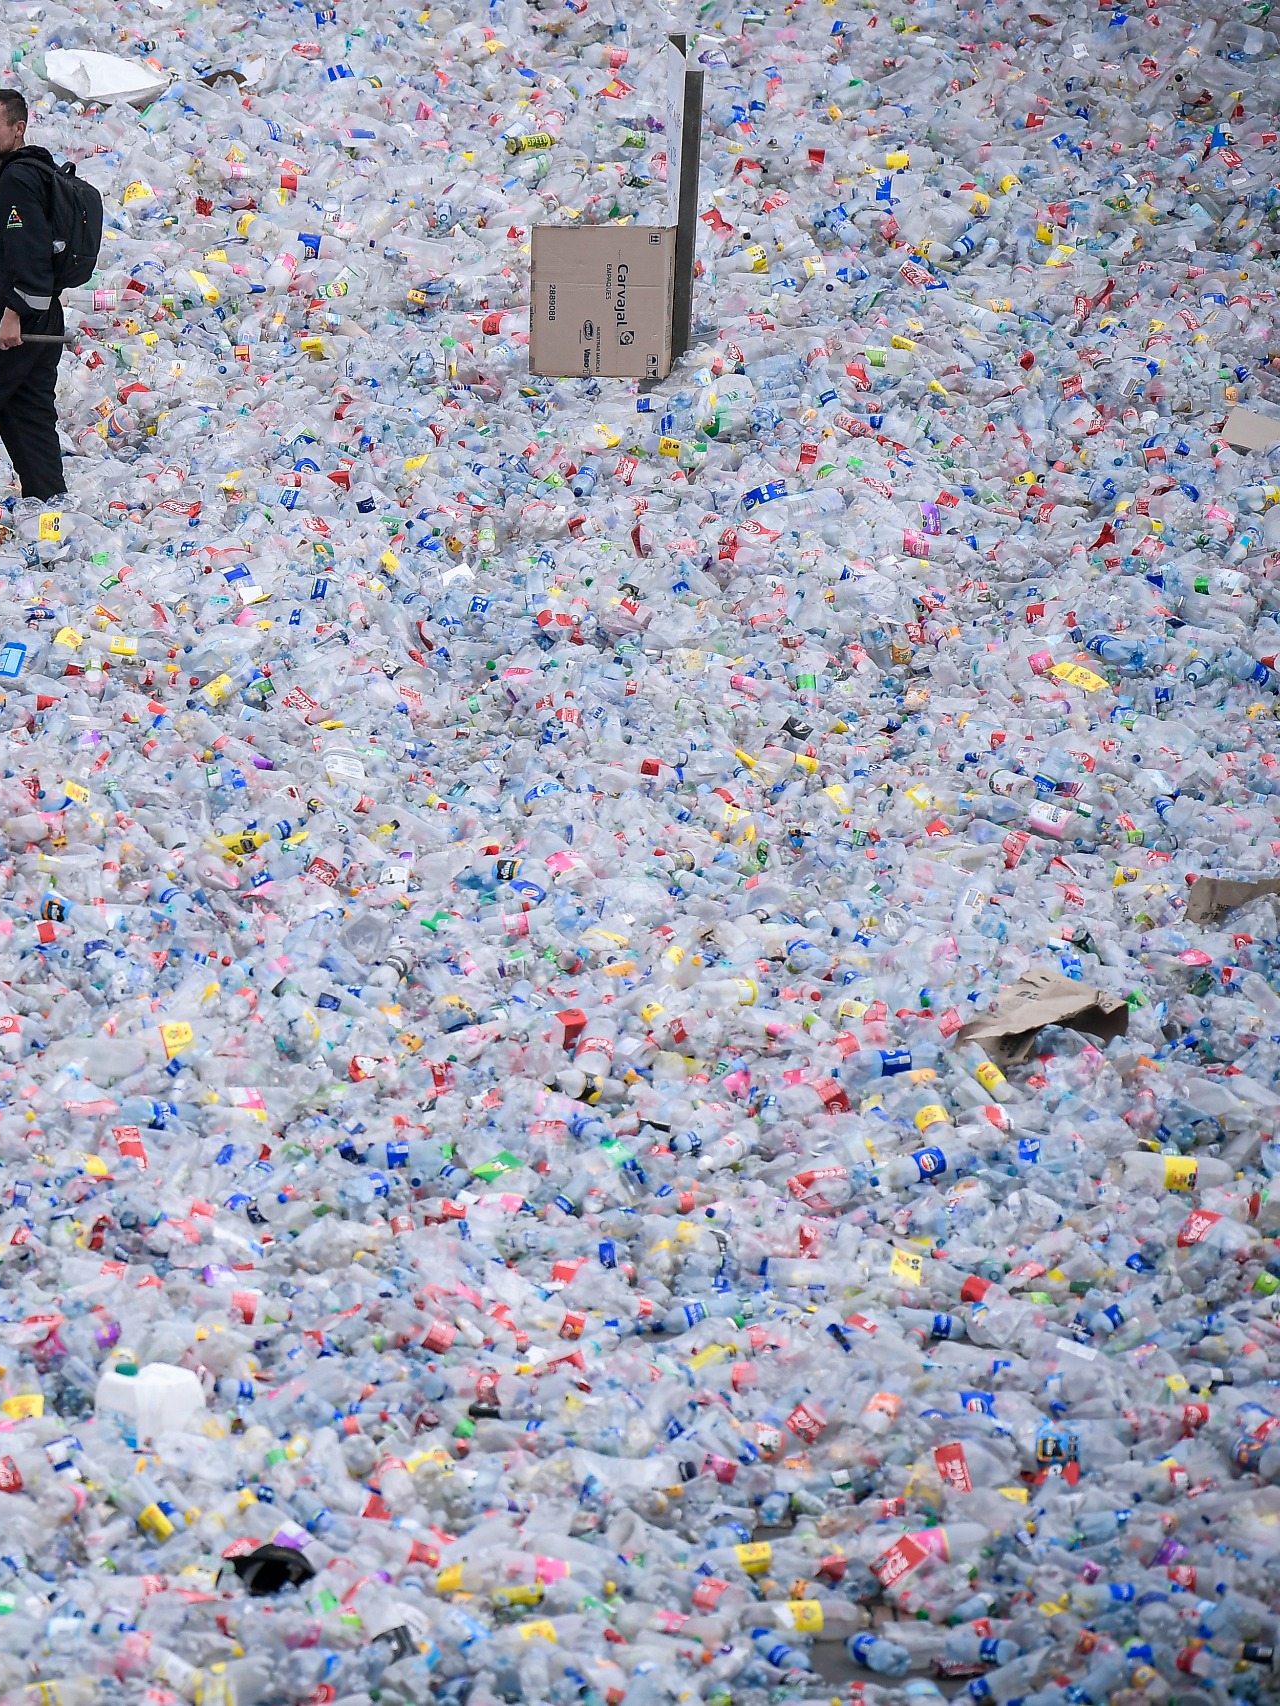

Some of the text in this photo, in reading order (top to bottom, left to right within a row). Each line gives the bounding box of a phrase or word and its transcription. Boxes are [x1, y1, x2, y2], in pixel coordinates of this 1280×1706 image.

[527, 135, 548, 147] SPEED
[605, 263, 613, 300] EMPAQUES
[614, 264, 629, 328] Carvajal
[548, 284, 557, 321] 2889088
